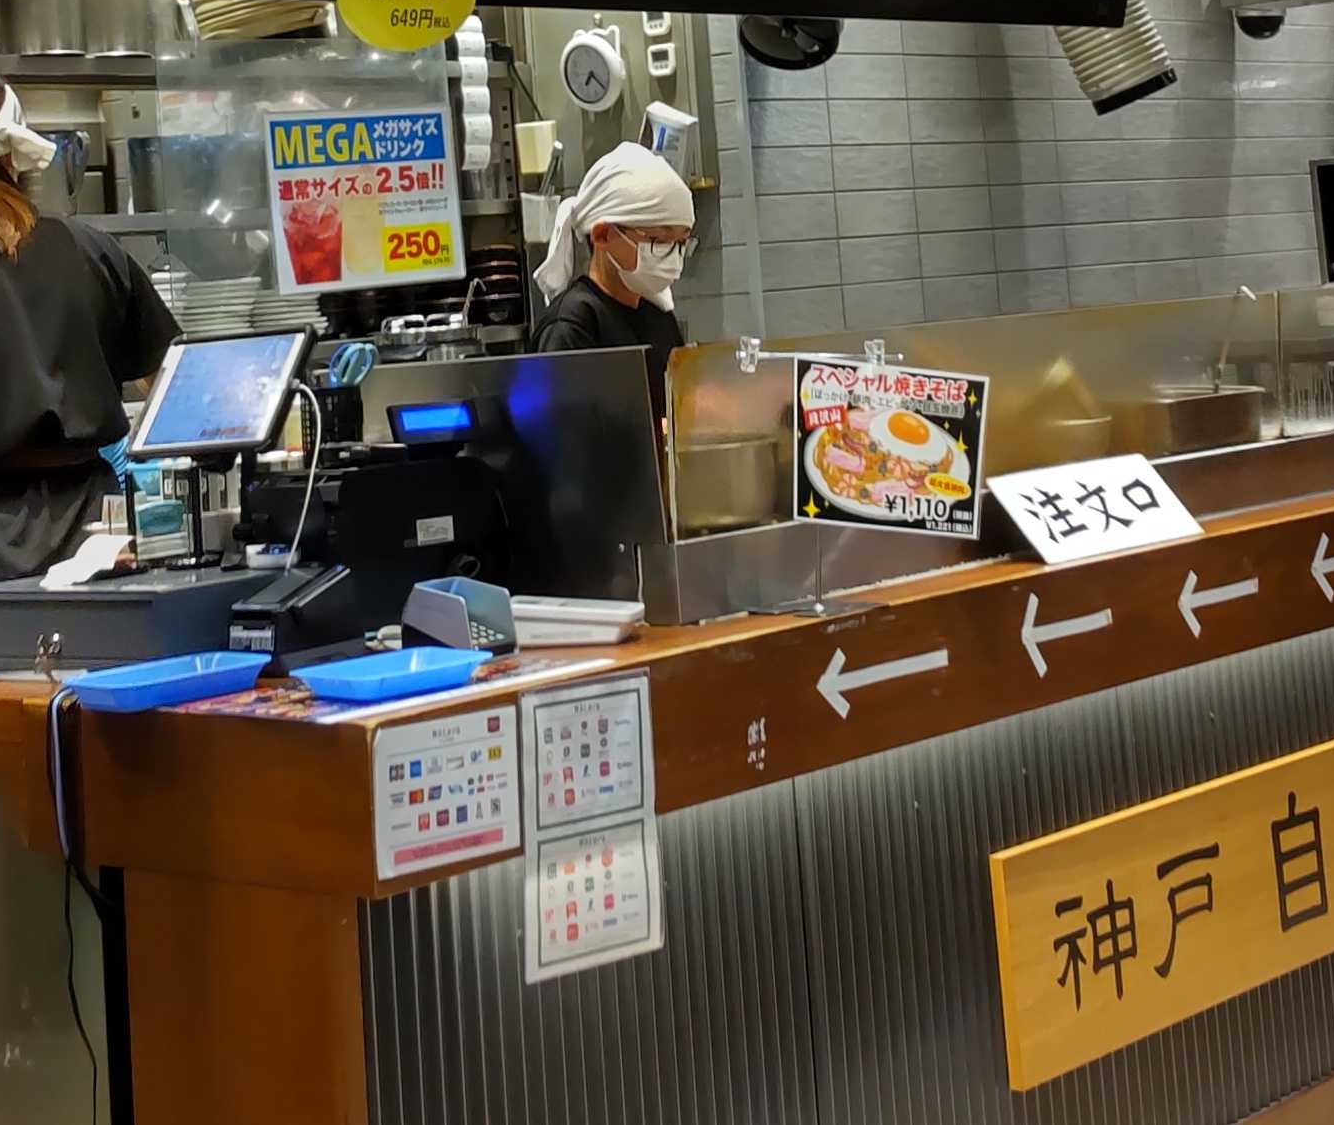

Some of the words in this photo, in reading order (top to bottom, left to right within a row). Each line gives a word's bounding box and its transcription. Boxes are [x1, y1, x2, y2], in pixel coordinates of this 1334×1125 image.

[273, 123, 376, 167] MEGA
[372, 117, 439, 139] メガサイズ
[375, 138, 425, 160] ドリンク
[387, 229, 450, 261] 250円
[810, 365, 967, 403] スペシャル焼きそば
[1018, 477, 1161, 544] 注文口
[1053, 842, 1220, 1012] 神戸
